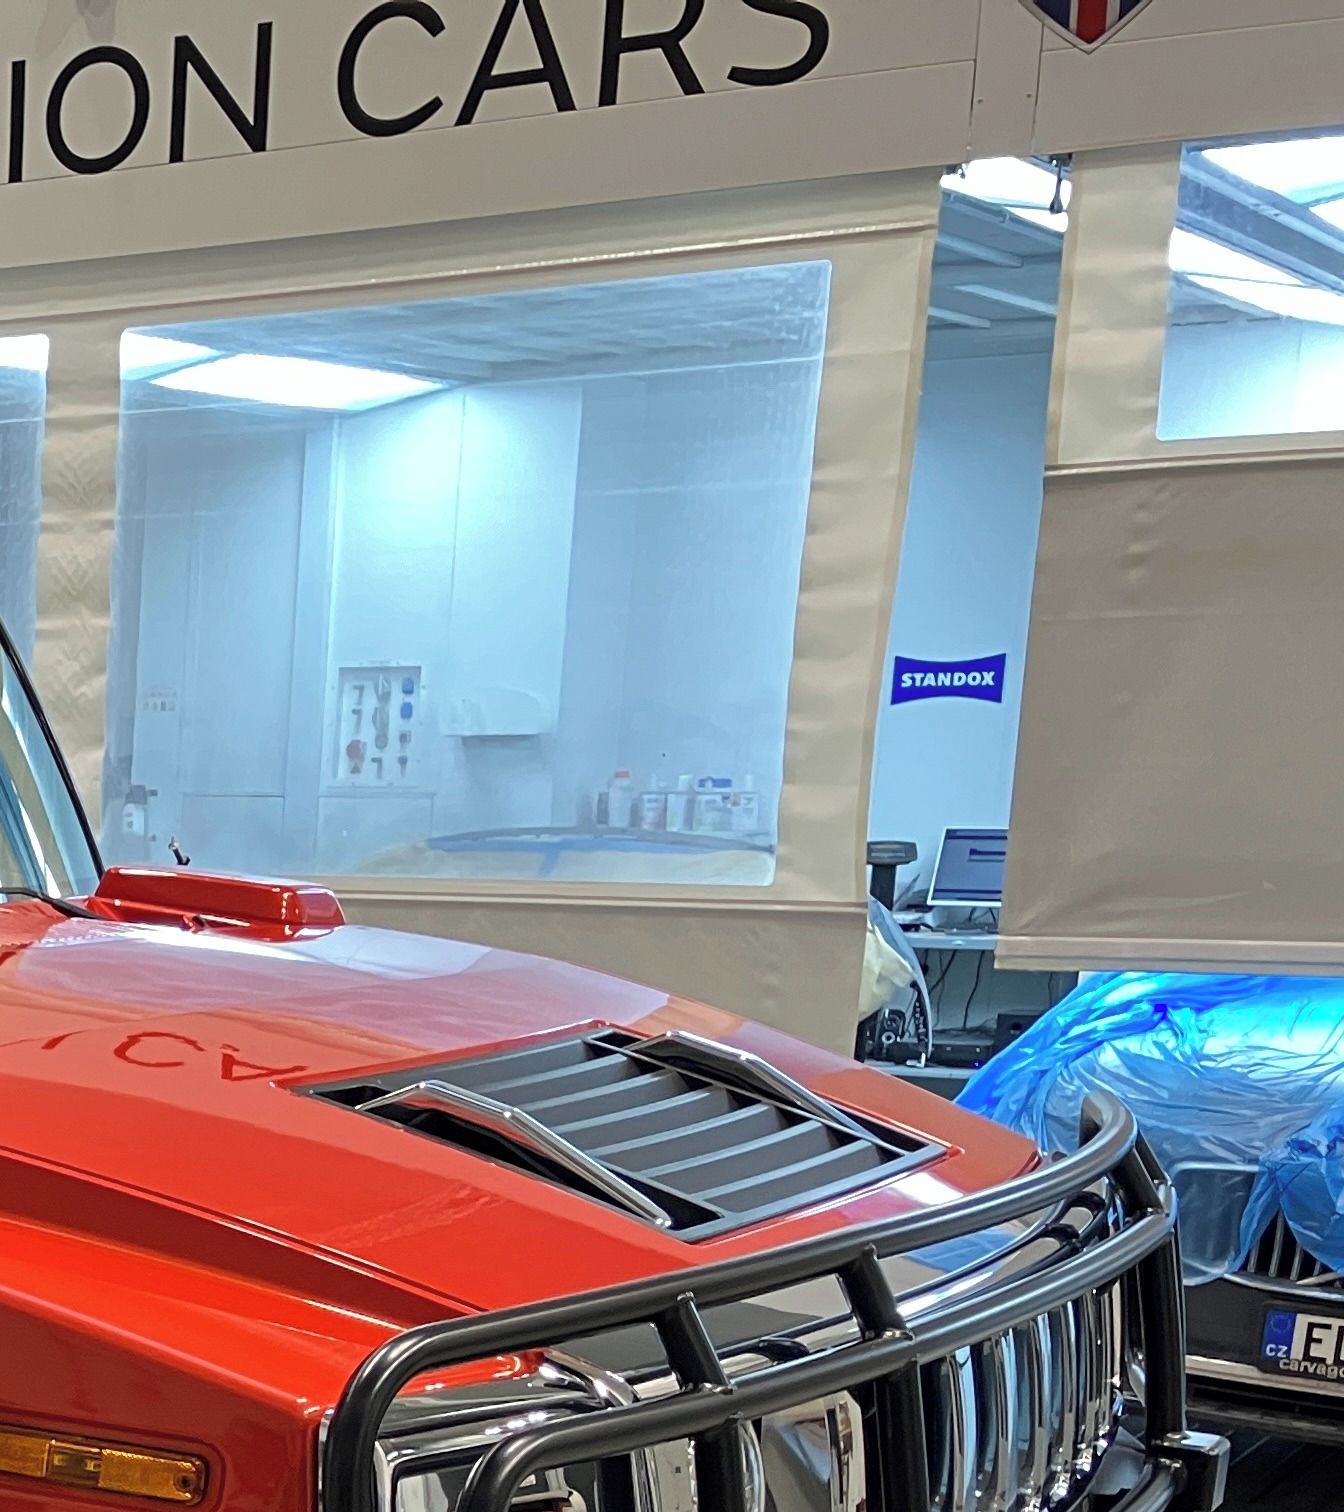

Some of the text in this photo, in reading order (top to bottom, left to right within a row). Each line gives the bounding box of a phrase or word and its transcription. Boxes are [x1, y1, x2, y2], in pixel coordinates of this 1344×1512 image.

[338, 0, 830, 138] CARS
[901, 670, 995, 688] STANDOX
[1265, 1343, 1288, 1358] CZ
[1302, 1322, 1344, 1364] E
